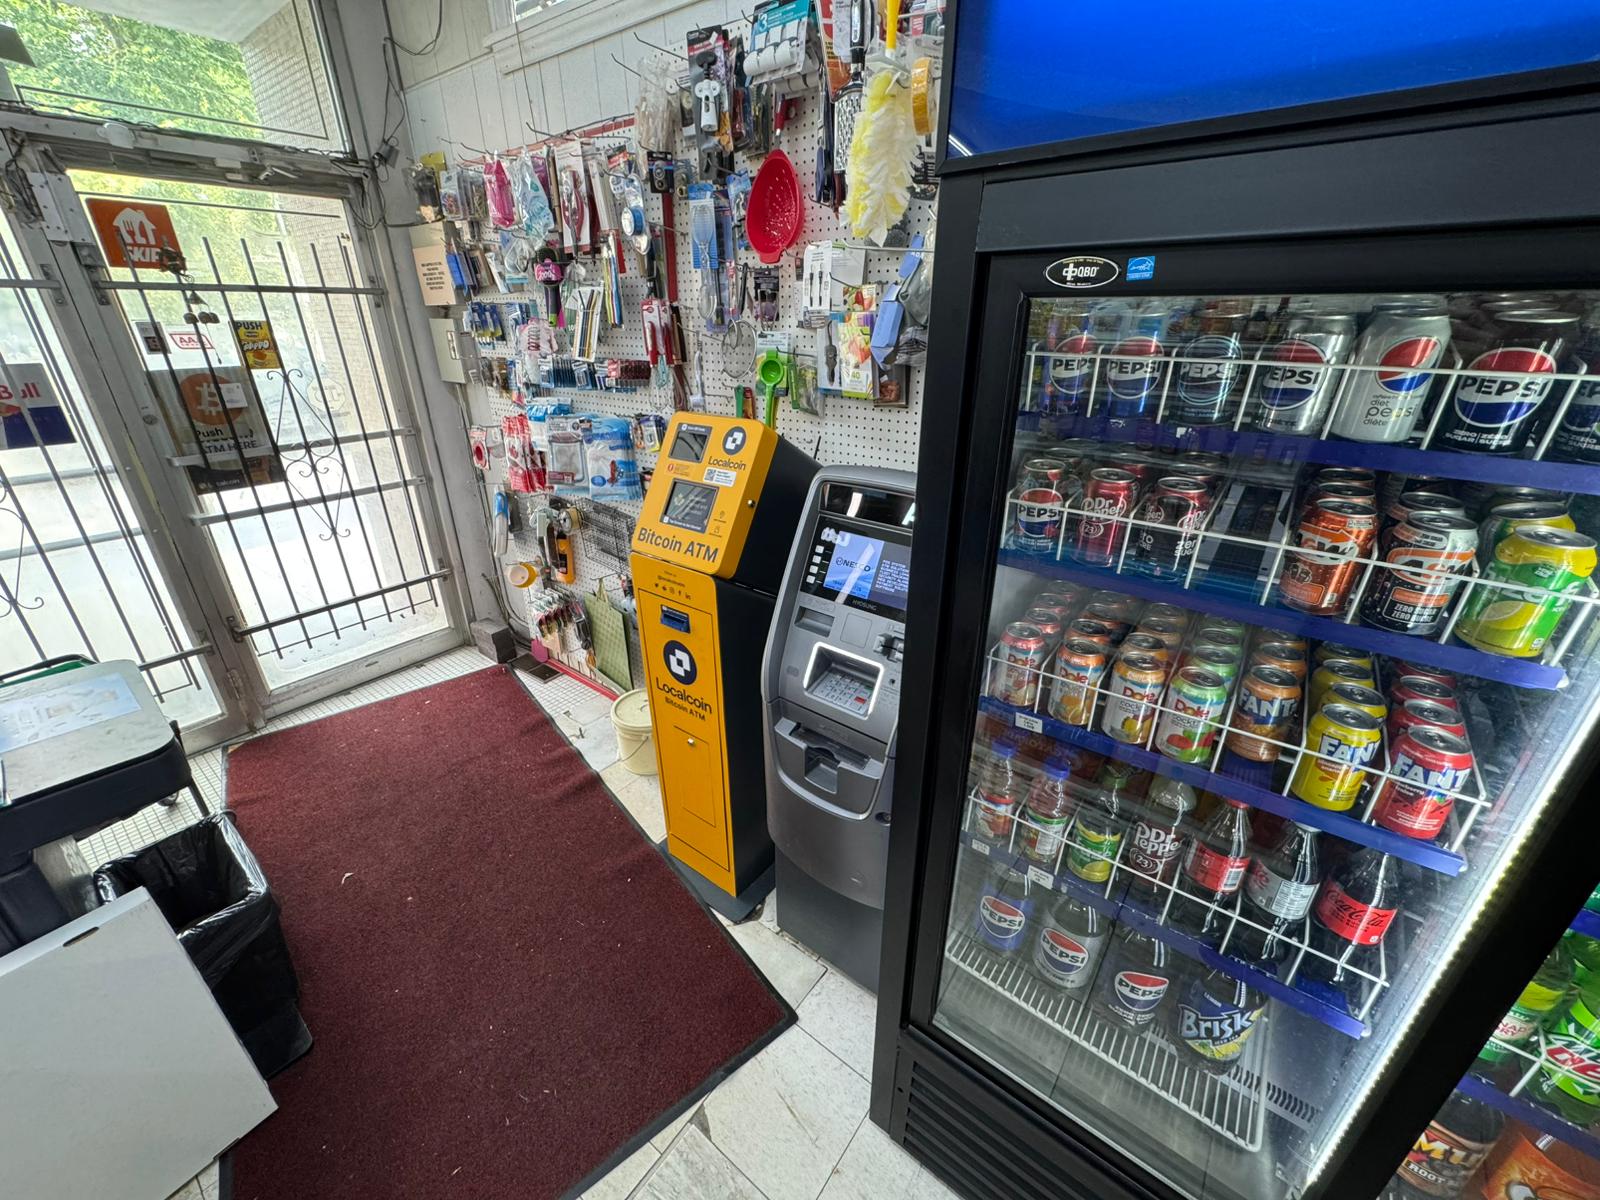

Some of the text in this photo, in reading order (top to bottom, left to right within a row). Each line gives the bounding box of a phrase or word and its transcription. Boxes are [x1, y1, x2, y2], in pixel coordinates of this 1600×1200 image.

[1052, 358, 1096, 372] PEPS
[1460, 376, 1549, 398] PEPSI
[1364, 402, 1417, 420] pepsi
[708, 456, 747, 471] Localcoin
[638, 527, 719, 563] Bitcoin ATM
[1394, 603, 1414, 613] ZERO
[656, 676, 712, 715] Localcoin
[689, 708, 706, 722] ATM
[1174, 698, 1211, 720] Dole
[1150, 827, 1177, 844] Dr
[1136, 854, 1150, 868] 23
[981, 901, 1023, 928] PEPSI
[1042, 935, 1086, 965] PEPSI
[1407, 1162, 1447, 1185] ROOT
